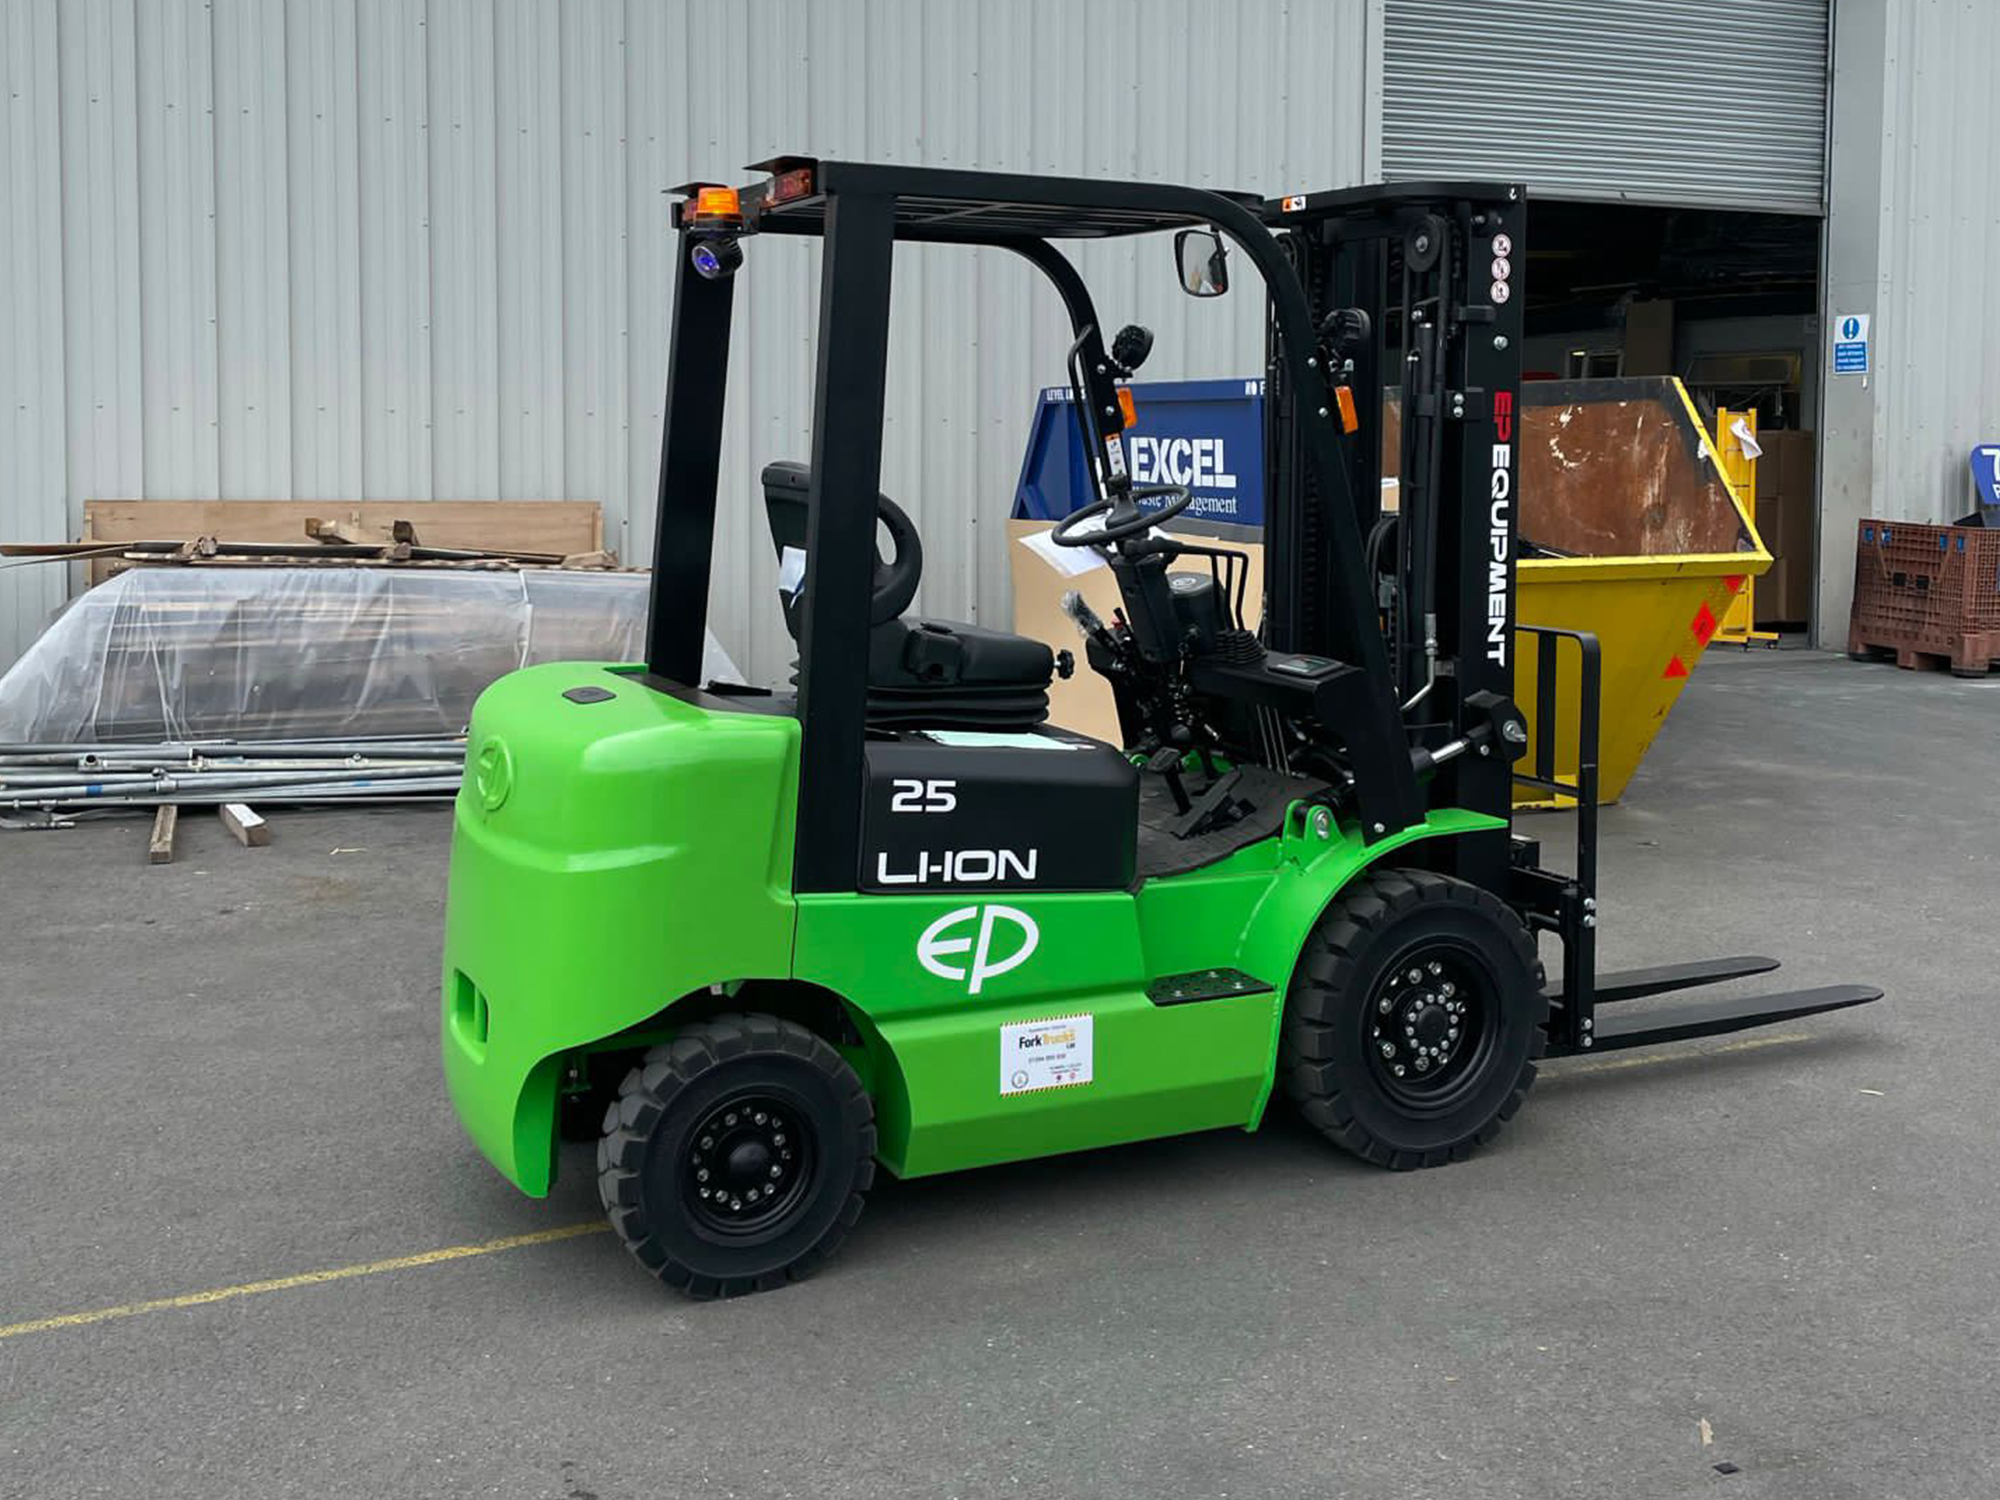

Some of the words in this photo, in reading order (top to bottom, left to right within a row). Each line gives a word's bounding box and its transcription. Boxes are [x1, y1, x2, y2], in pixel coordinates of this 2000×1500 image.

[1494, 391, 1512, 441] EP
[1130, 437, 1236, 488] EXCEL
[1487, 444, 1511, 667] EQUIPMENT
[891, 779, 957, 812] 25
[877, 849, 1037, 883] LI-ION
[917, 904, 1040, 994] EP
